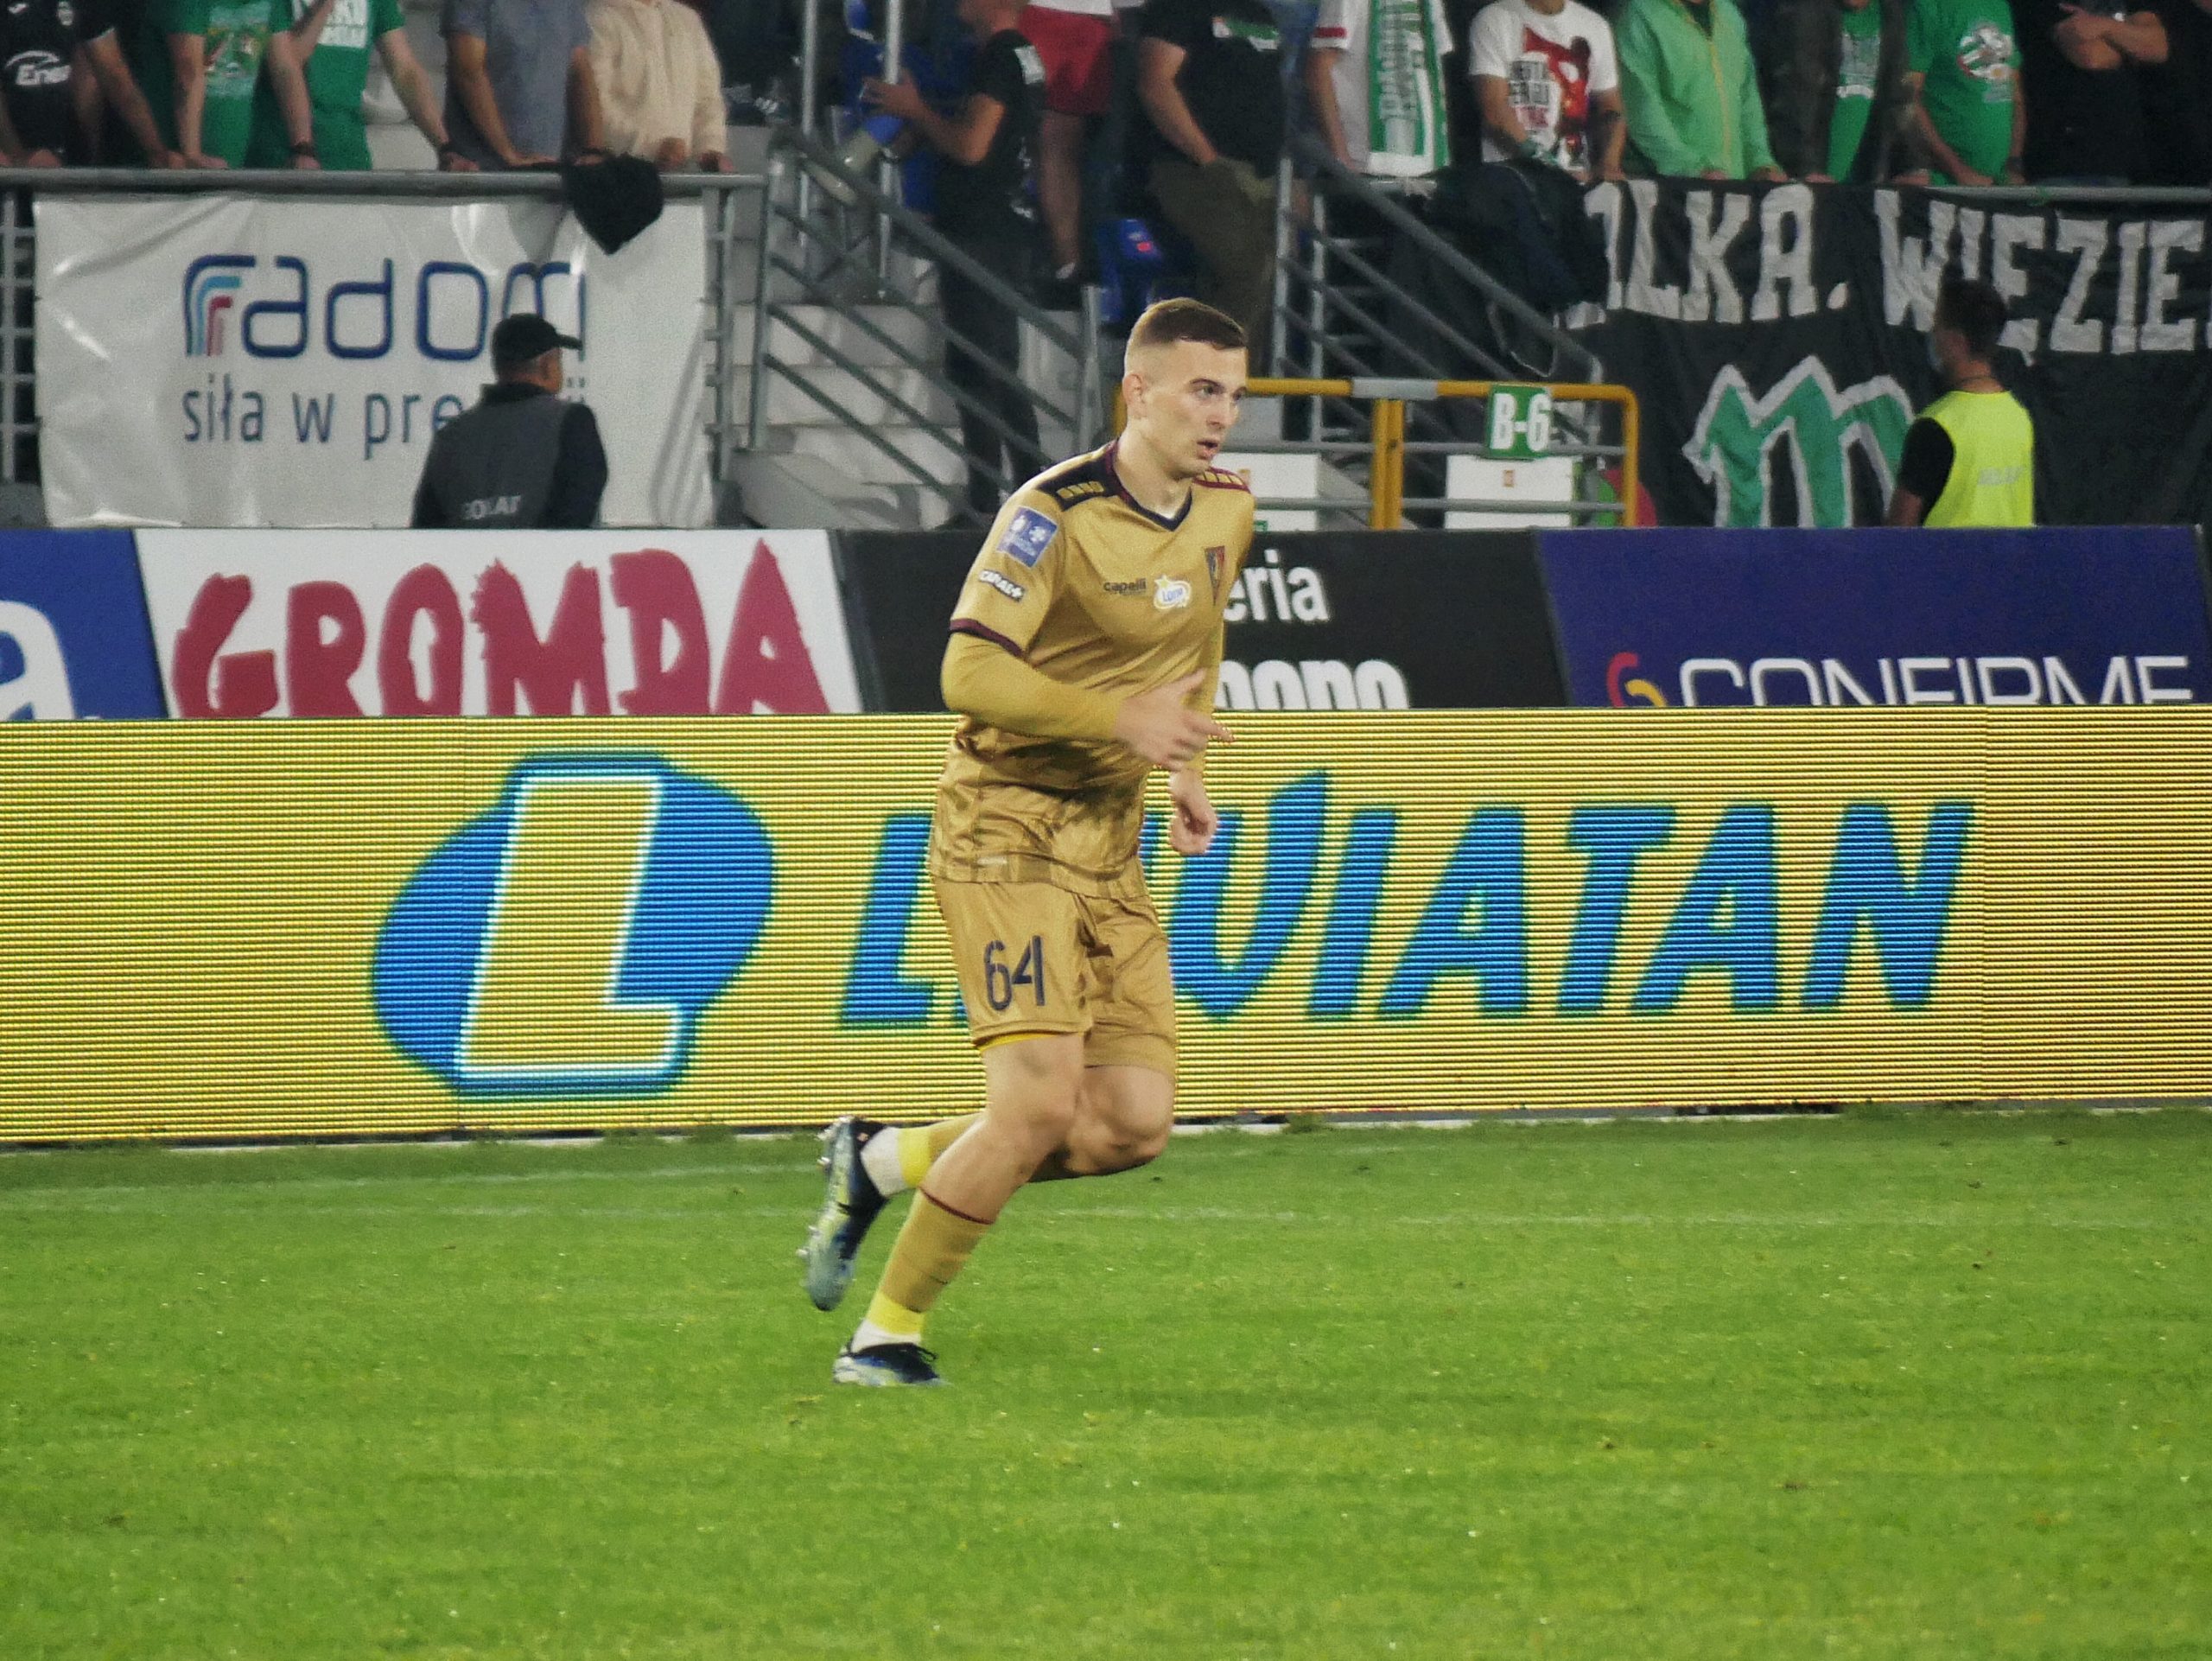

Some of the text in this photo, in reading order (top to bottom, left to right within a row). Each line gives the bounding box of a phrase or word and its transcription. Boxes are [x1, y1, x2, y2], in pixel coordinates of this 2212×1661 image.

[184, 255, 586, 362] radom
[1873, 189, 2212, 366] WIĘZIE
[182, 373, 264, 442] siła
[292, 392, 335, 443] w
[1490, 393, 1552, 452] B-6
[174, 538, 831, 719] GROMDA
[837, 767, 1975, 1027] LWIATAN
[983, 936, 1046, 1012] 64
